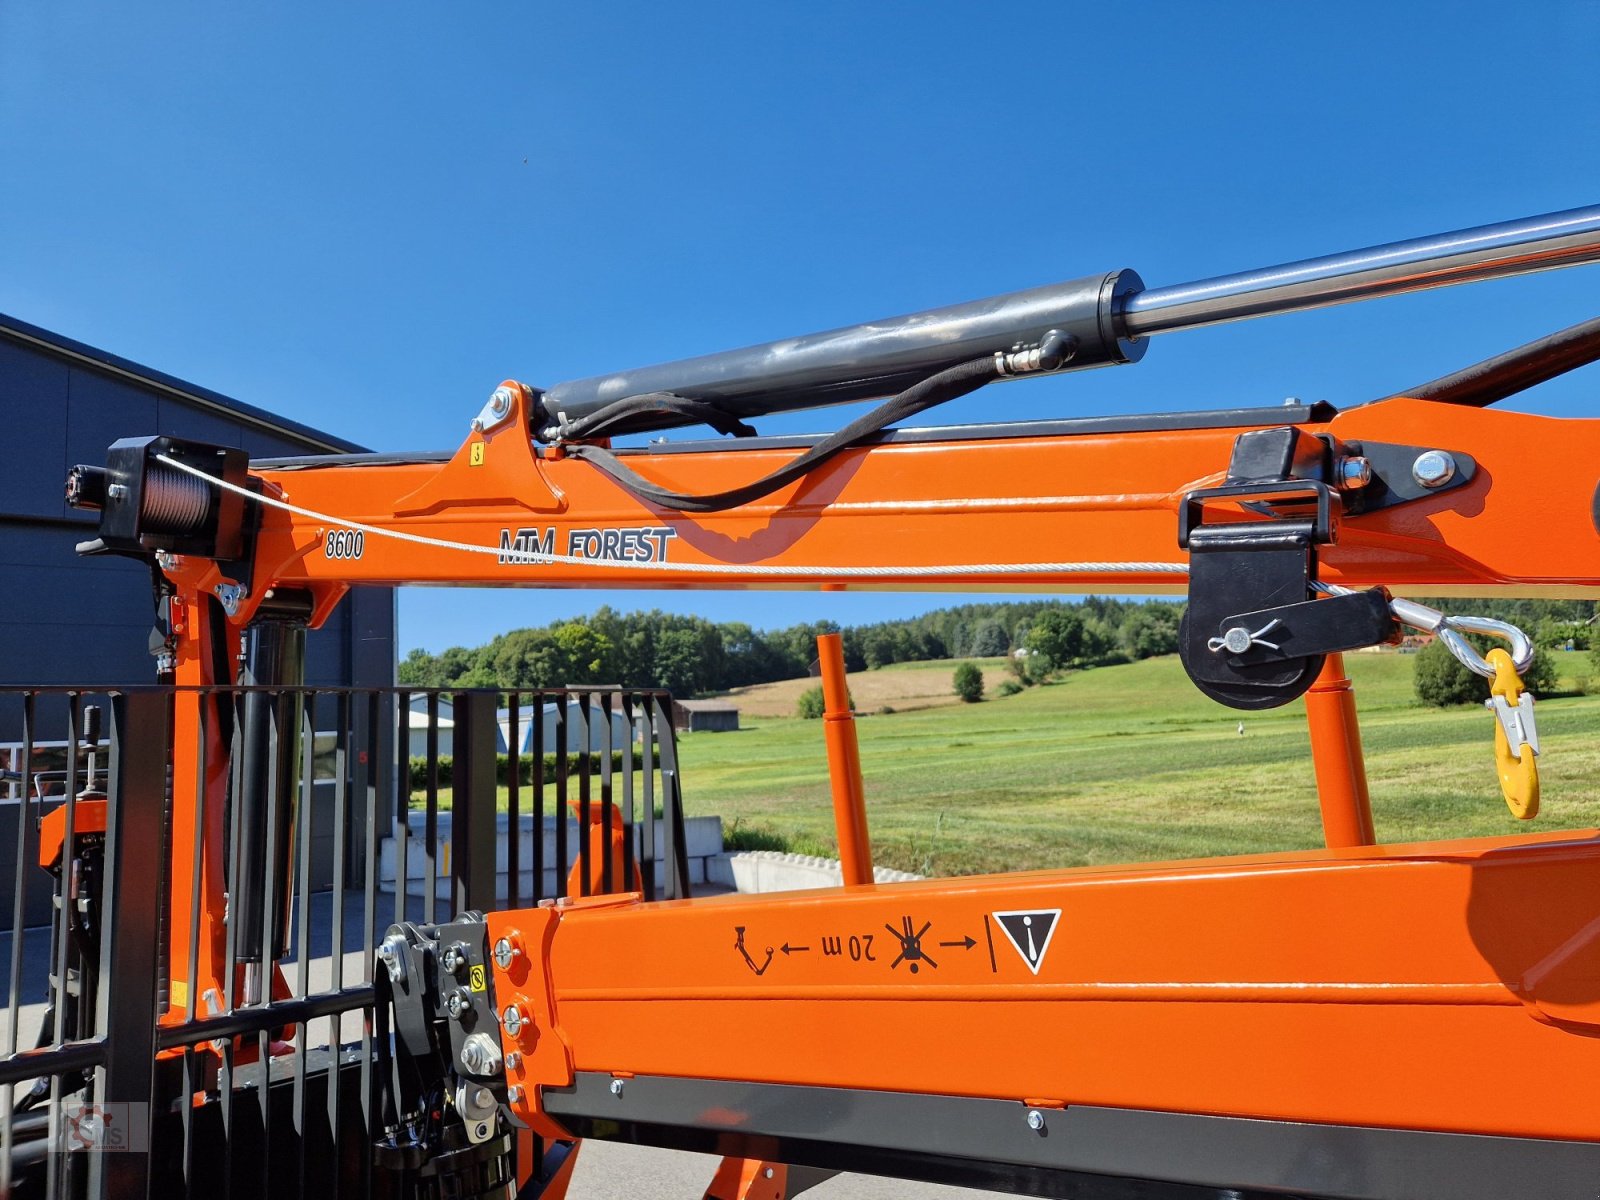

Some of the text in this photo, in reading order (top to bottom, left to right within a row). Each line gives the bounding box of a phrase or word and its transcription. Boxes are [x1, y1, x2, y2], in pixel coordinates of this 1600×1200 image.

[326, 530, 364, 559] 8600
[498, 527, 677, 564] MTM FOREST
[822, 935, 876, 961] 20 m
